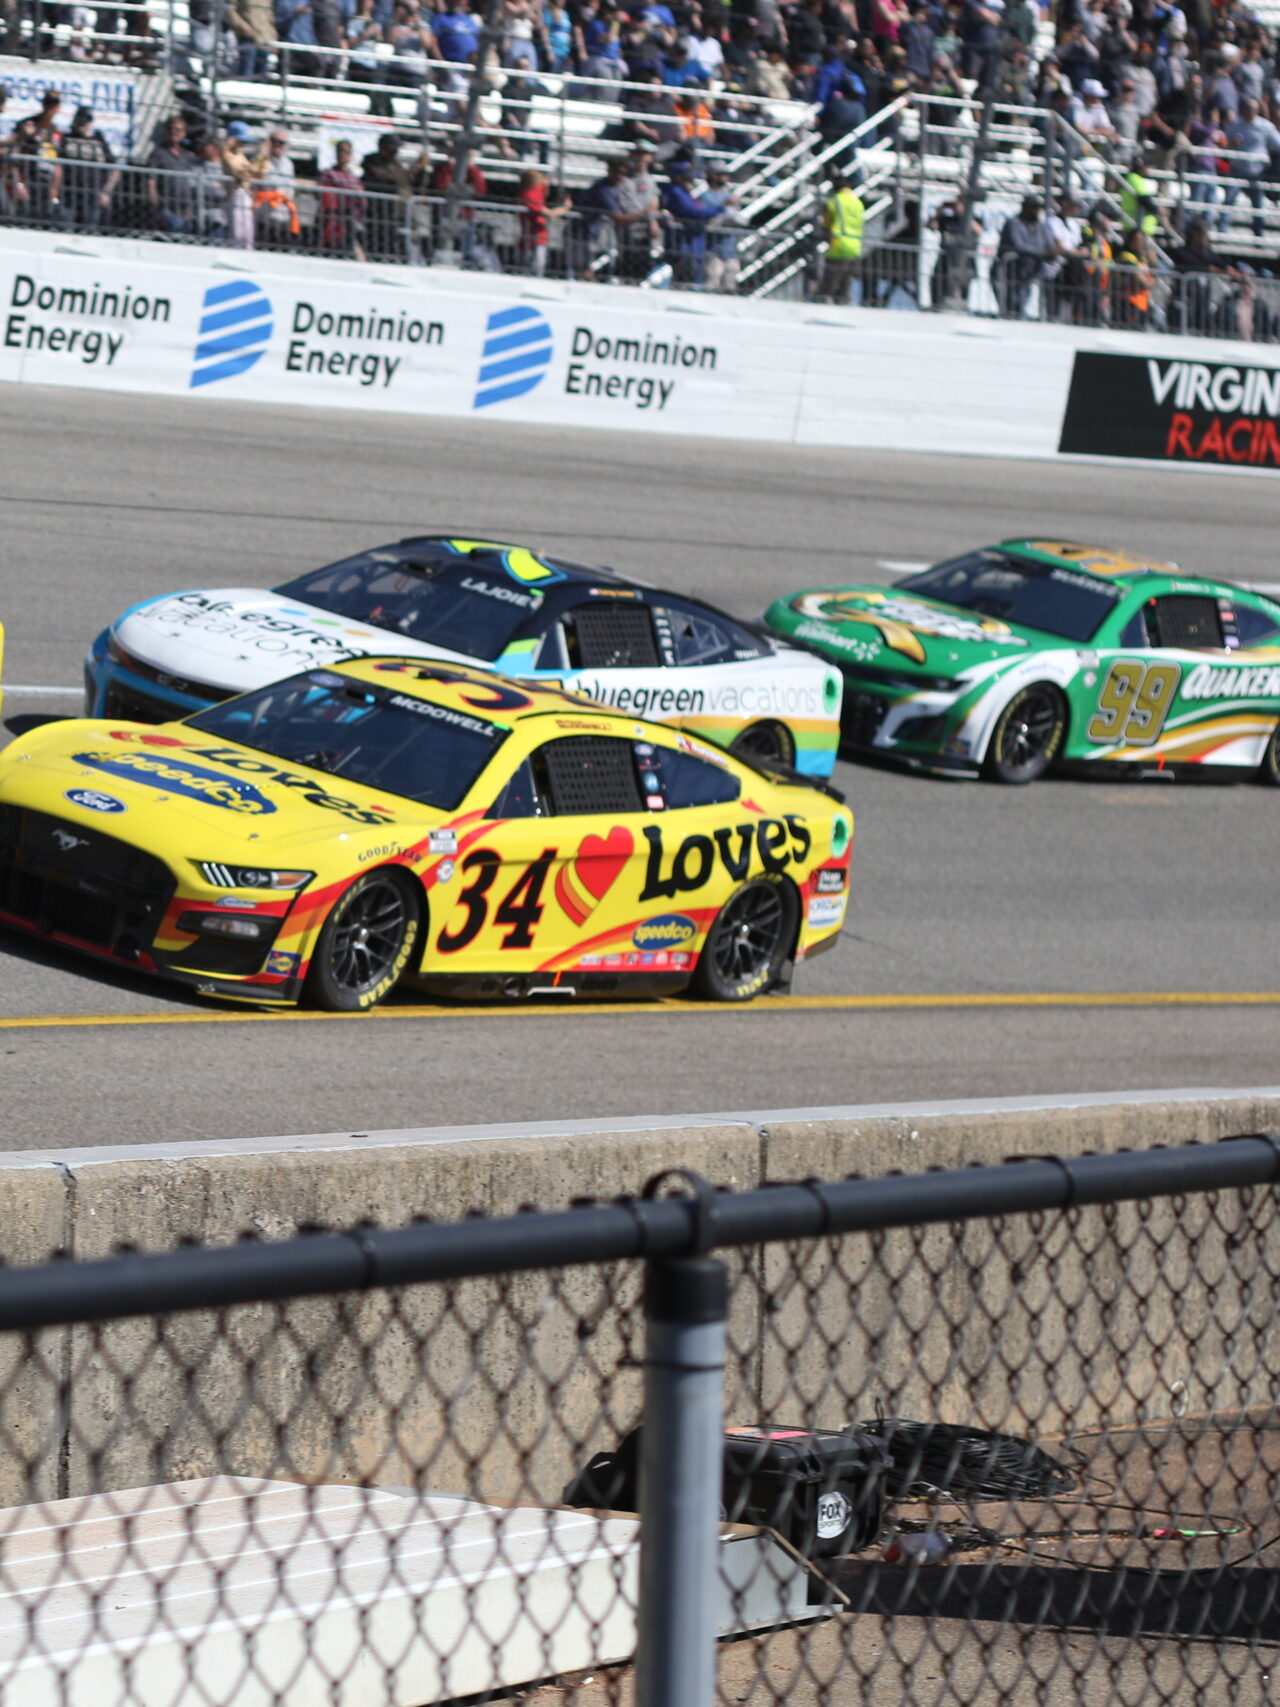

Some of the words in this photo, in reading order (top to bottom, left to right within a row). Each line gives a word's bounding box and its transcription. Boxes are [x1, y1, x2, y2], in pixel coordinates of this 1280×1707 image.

[10, 274, 171, 322] Dominion
[4, 315, 124, 366] Energy
[292, 302, 444, 345] Dominion
[285, 341, 401, 388] Energy
[570, 327, 718, 370] Dominion
[564, 364, 675, 411] Energy
[460, 577, 529, 607] LAJOIE
[1087, 658, 1181, 746] 99
[72, 789, 118, 812] Ford
[436, 847, 560, 955] 34
[635, 921, 693, 944] speedco
[820, 1503, 842, 1521] FOX
